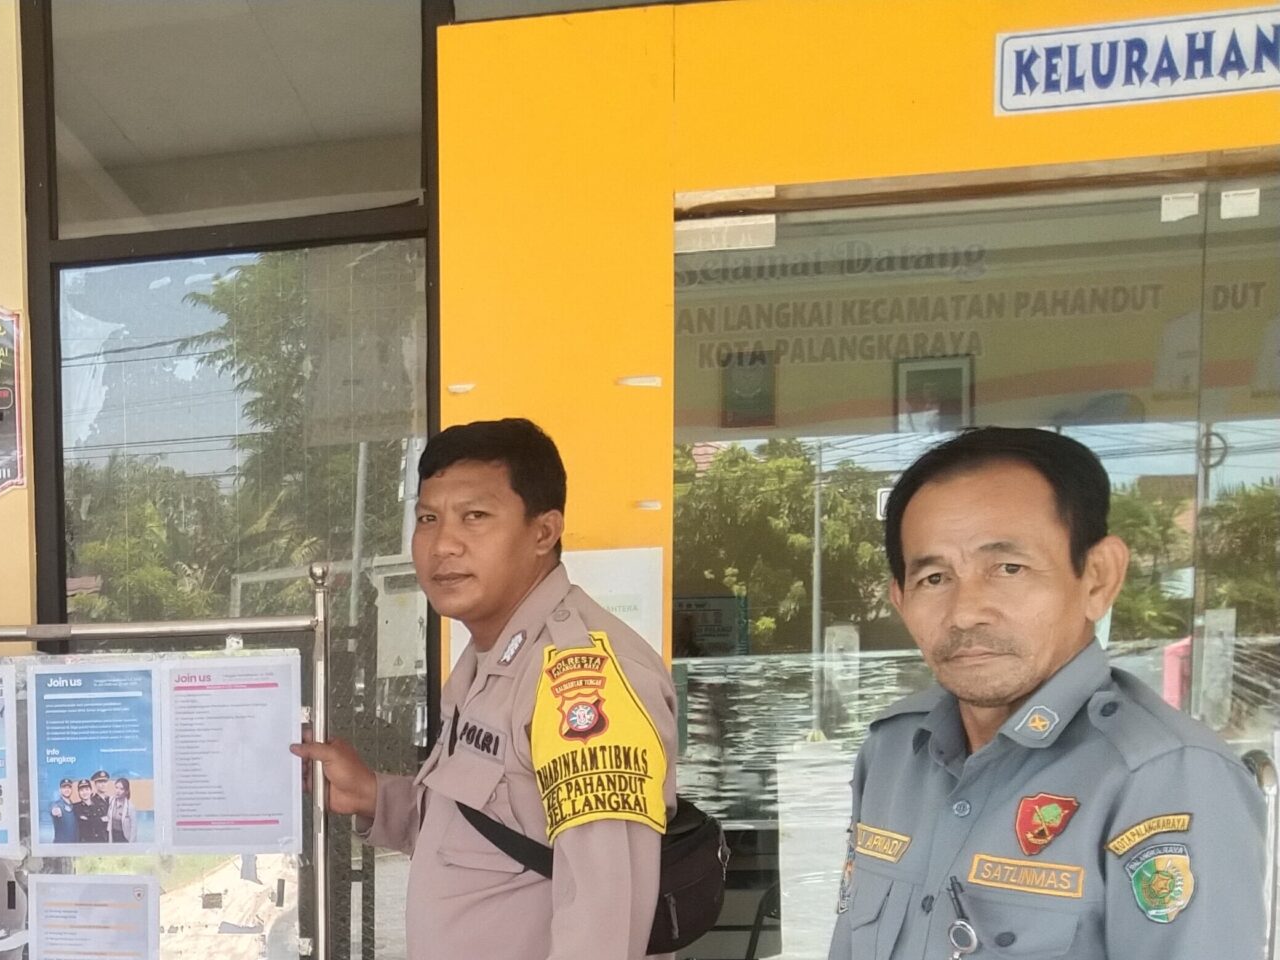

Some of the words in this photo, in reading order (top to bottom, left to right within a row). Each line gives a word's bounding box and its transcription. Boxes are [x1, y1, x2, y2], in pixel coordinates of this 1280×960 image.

[1013, 24, 1280, 97] KELURAHAN
[834, 239, 987, 283] Datang
[723, 300, 833, 332] LANGKAI
[840, 292, 1006, 327] KECAMATAN
[1013, 283, 1164, 318] PAHANDUT
[1211, 281, 1267, 313] DUT
[697, 340, 767, 369] KOTA
[774, 331, 983, 365] PALANGKARAYA
[175, 673, 197, 683] Join
[198, 674, 212, 682] us
[551, 656, 601, 675] POLRESTA
[47, 677, 69, 687] Join
[69, 678, 82, 687] us
[46, 748, 60, 756] Info
[459, 721, 500, 756] POLRI
[46, 755, 77, 765] Lengkap
[536, 744, 649, 795] BHABINKAMTIBMAS
[980, 861, 1071, 890] SATLINMAS
